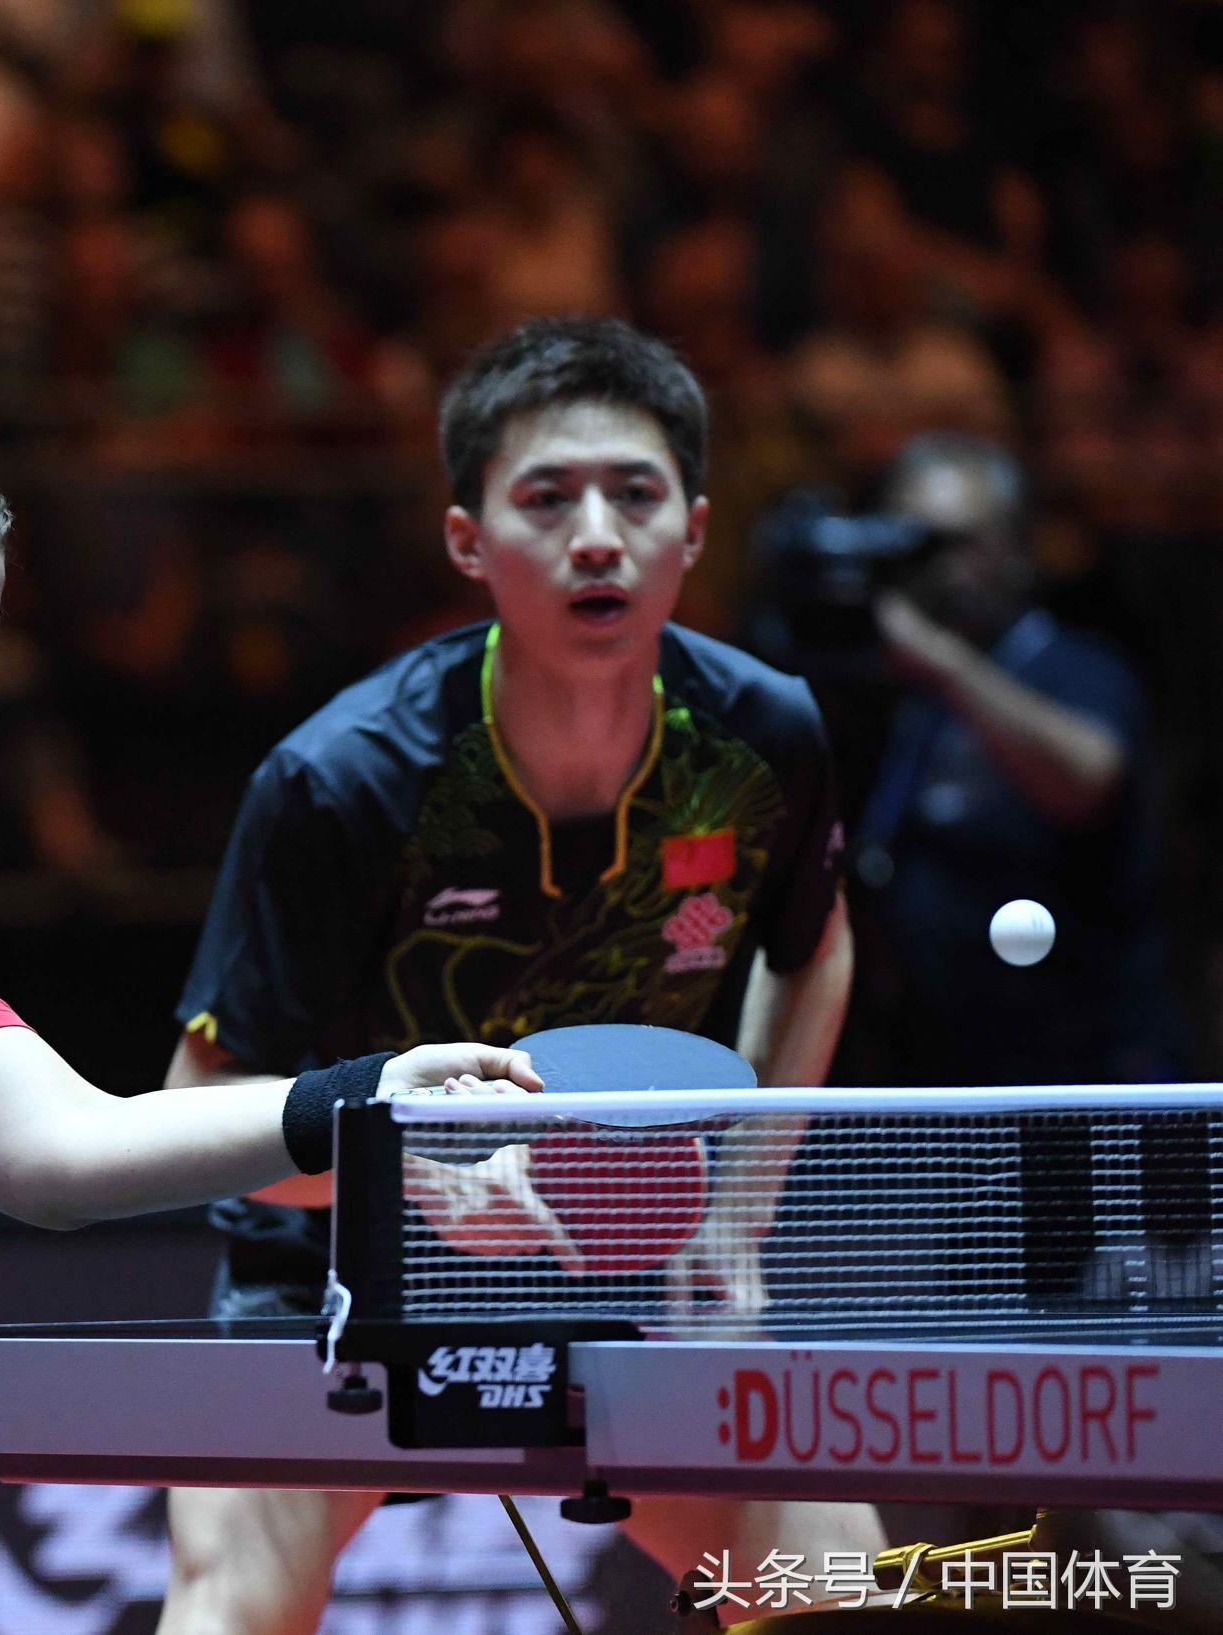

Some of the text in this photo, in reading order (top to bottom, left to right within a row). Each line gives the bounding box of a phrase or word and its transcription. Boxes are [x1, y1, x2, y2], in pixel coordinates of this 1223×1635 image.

[417, 1342, 557, 1397] 红双喜
[477, 1385, 553, 1408] DHS
